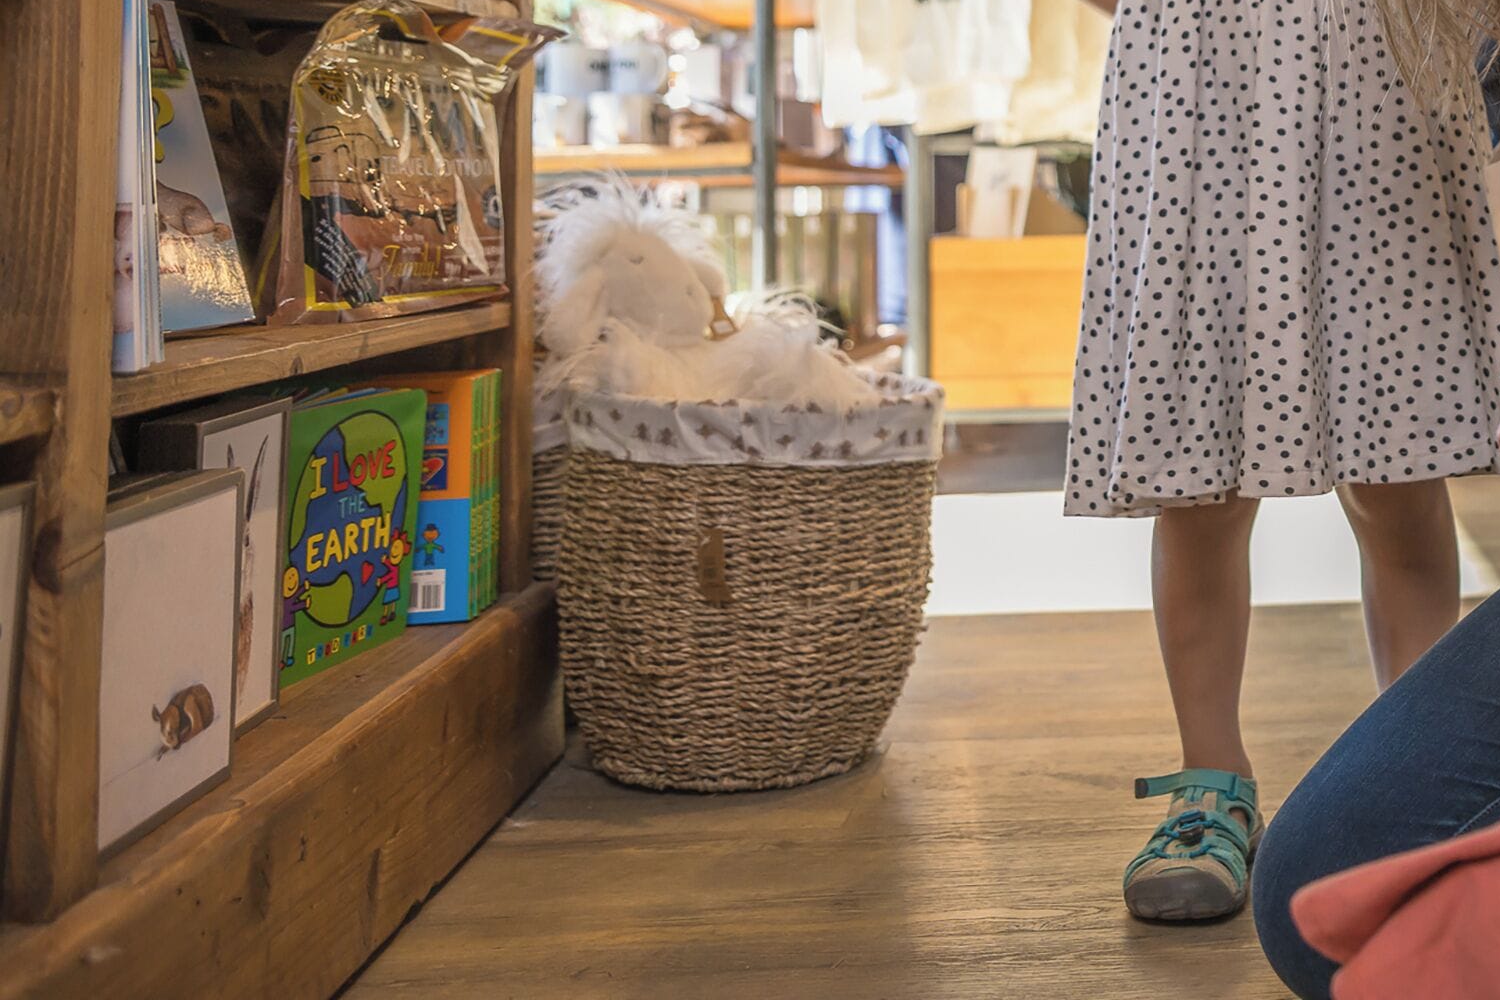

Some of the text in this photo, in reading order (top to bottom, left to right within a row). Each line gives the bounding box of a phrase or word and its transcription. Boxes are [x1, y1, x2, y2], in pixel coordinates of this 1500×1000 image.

[310, 439, 397, 499] I LOVE
[338, 492, 368, 520] THE
[306, 511, 392, 573] EARTH
